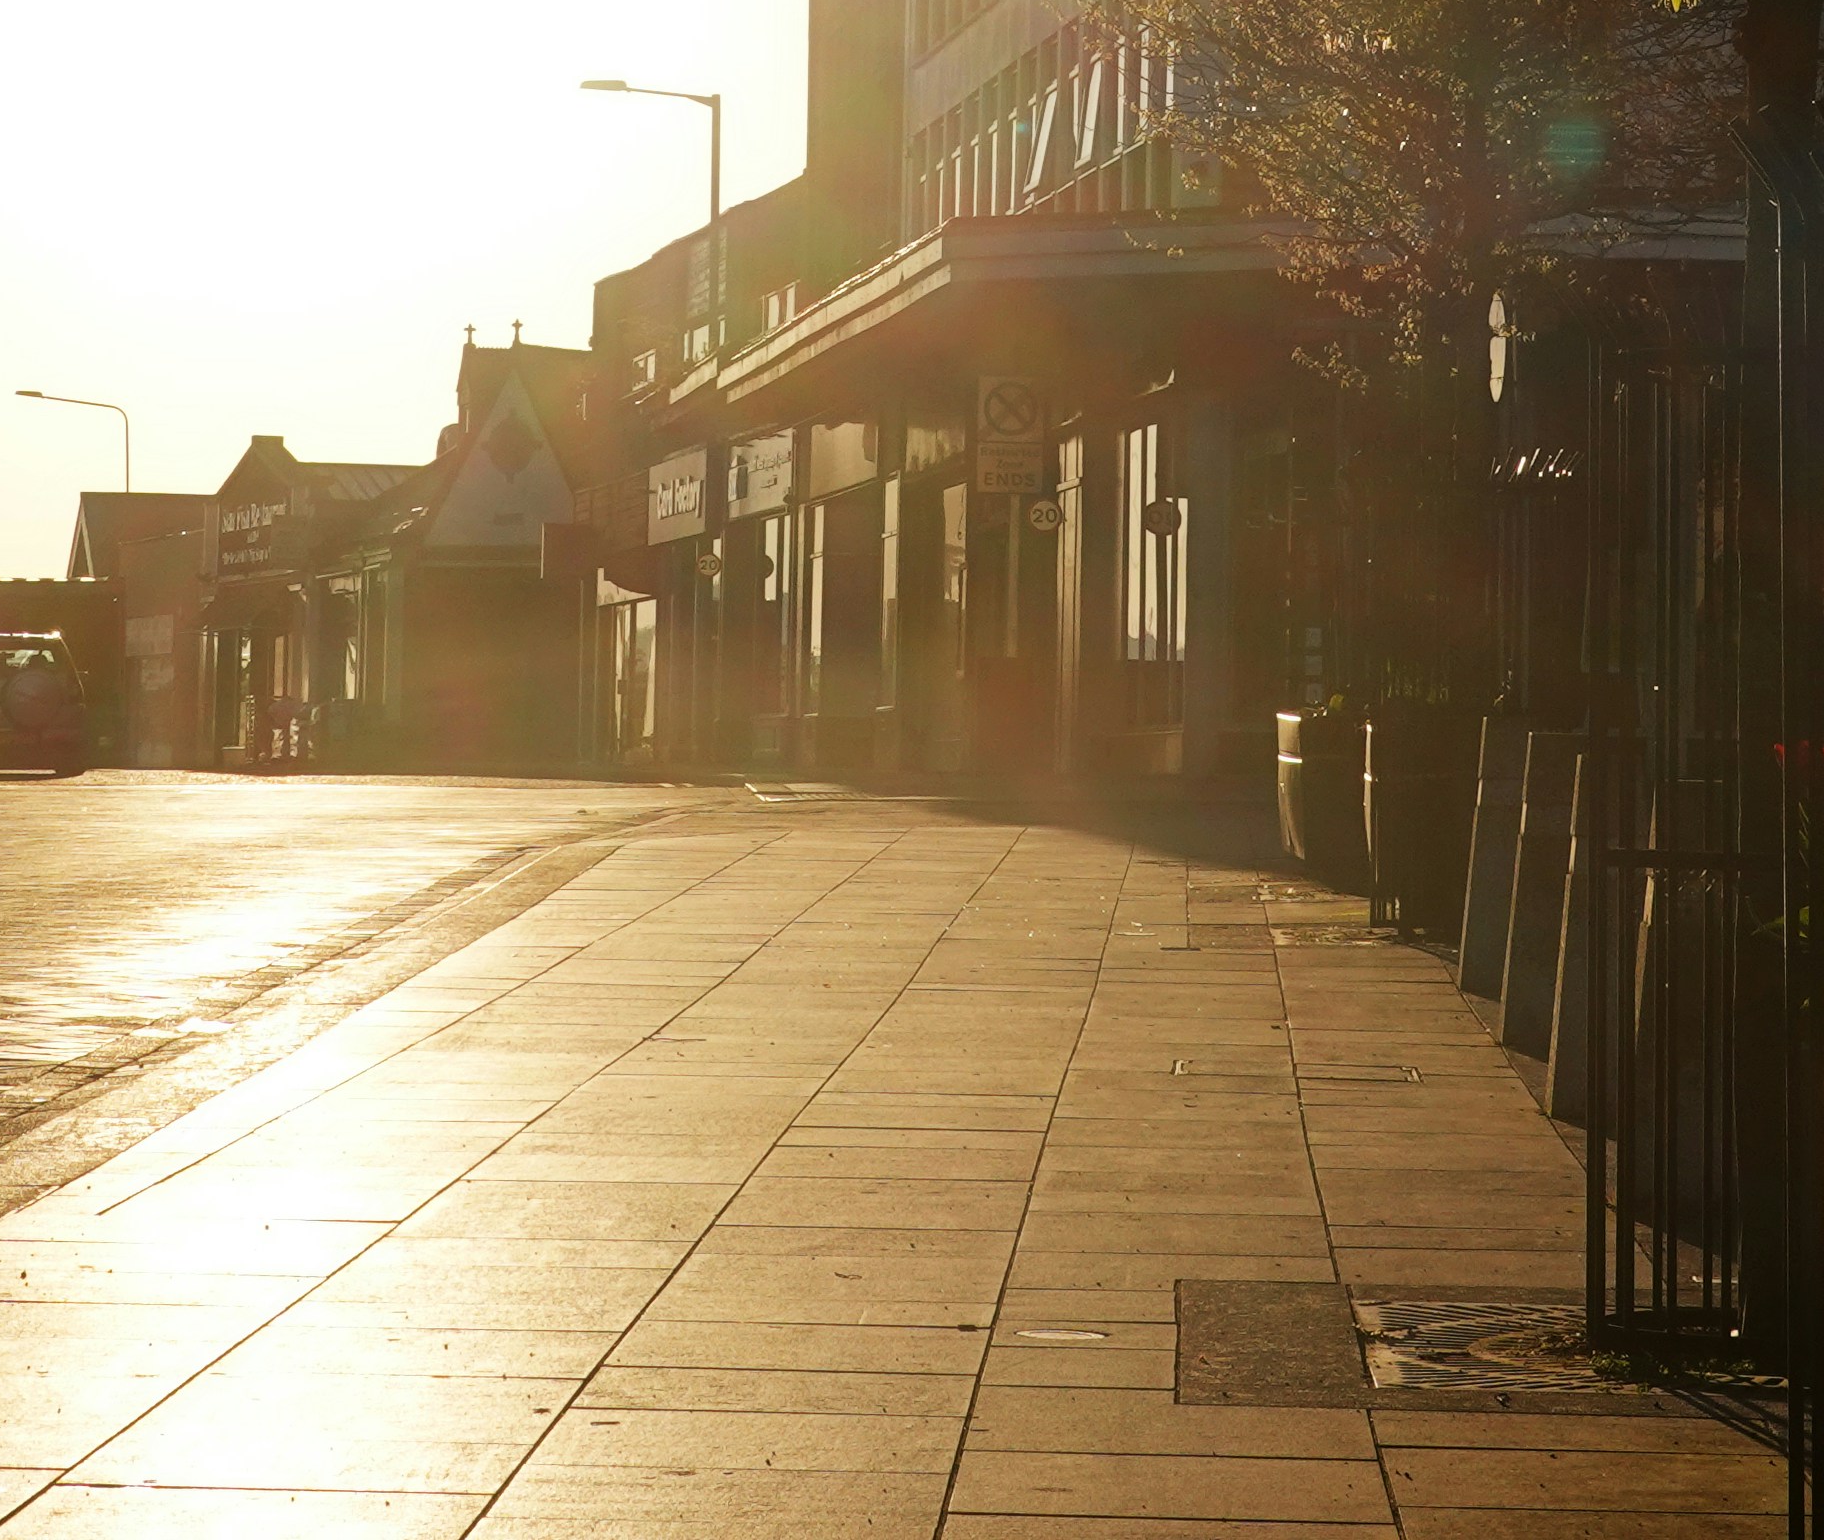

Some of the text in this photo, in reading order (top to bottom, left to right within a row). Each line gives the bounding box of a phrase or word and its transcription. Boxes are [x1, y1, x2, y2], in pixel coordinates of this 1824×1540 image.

[983, 472, 1036, 488] ENDS
[1032, 507, 1058, 524] 20
[700, 559, 718, 571] 20
